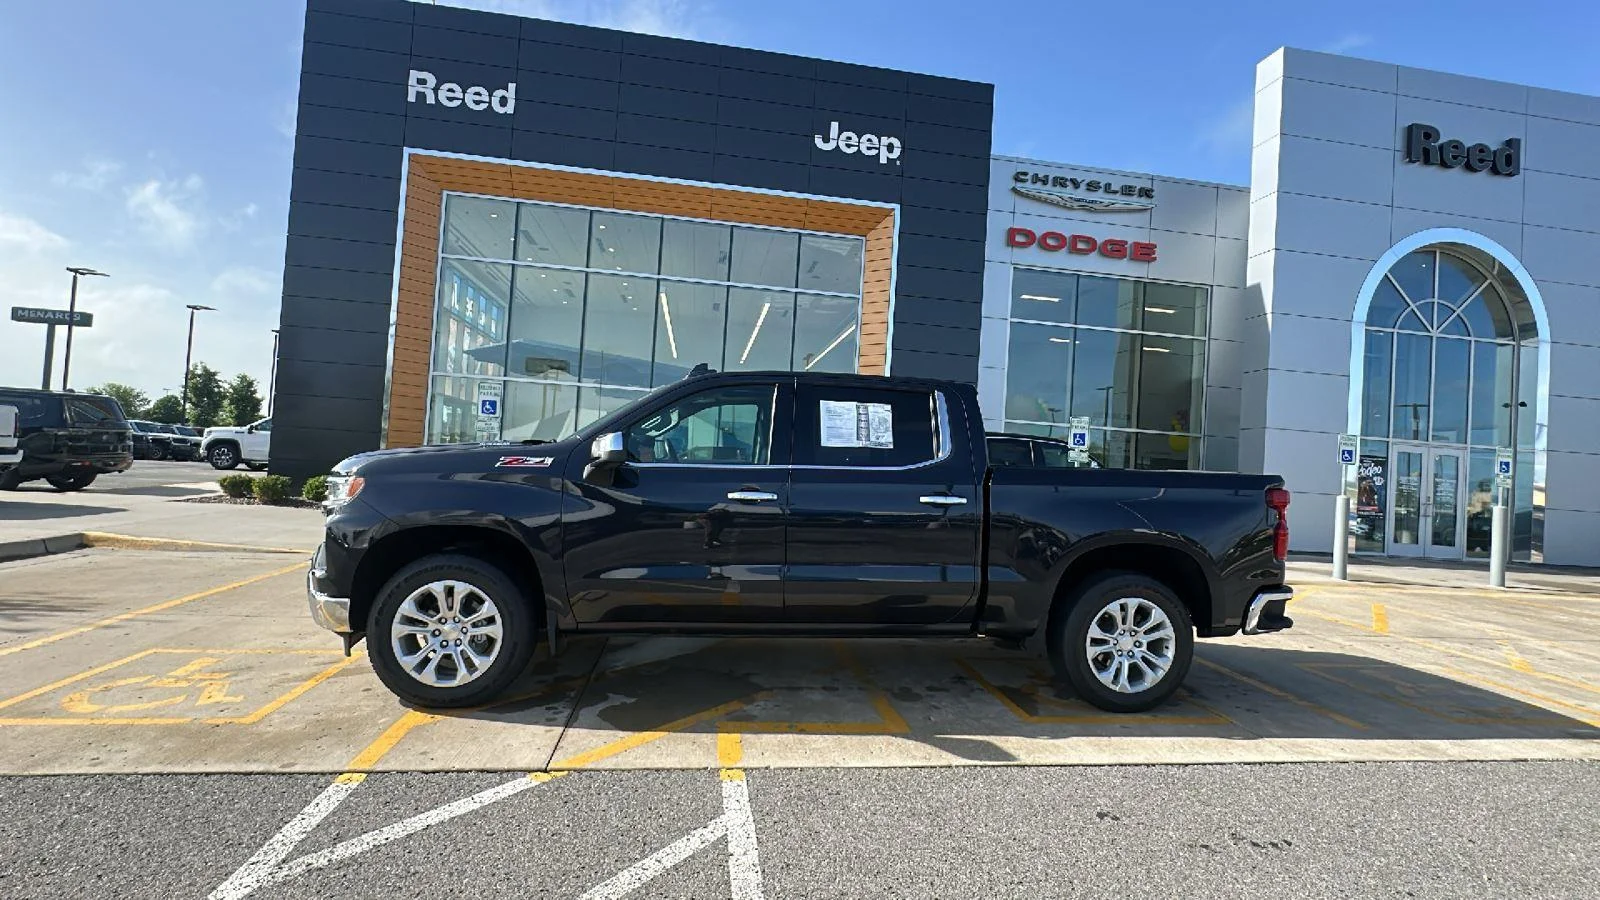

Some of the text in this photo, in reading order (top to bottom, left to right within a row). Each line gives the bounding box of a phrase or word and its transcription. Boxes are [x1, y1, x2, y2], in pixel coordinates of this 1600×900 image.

[407, 69, 517, 115] Reed
[814, 121, 902, 165] Jeep
[1405, 122, 1521, 177] Reed
[1013, 171, 1155, 199] CHRYSLER
[1007, 227, 1157, 262] DODGE
